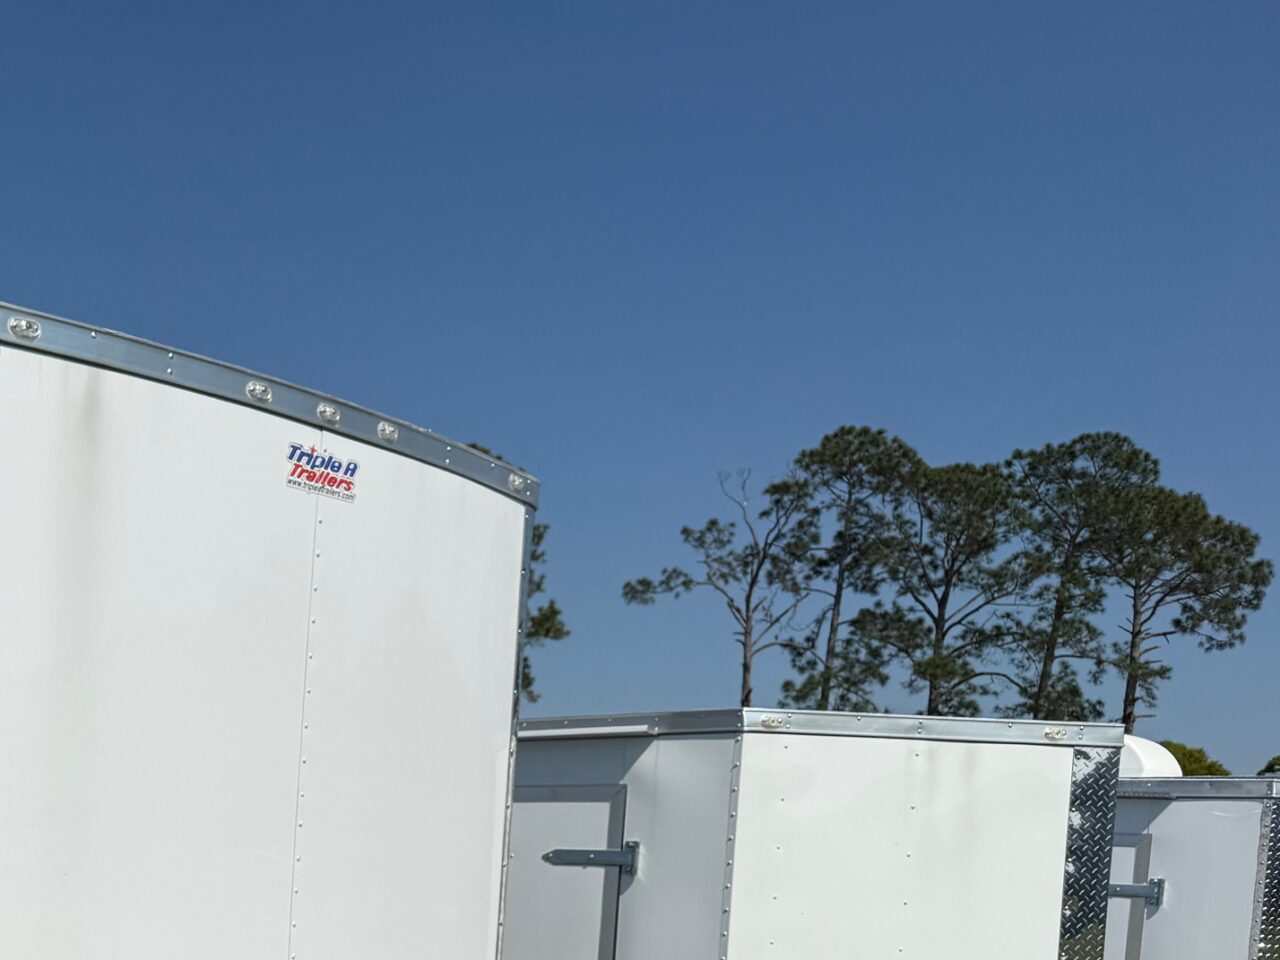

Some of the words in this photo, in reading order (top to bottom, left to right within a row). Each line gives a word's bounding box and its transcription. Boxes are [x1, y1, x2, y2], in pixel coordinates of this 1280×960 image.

[288, 444, 342, 473] Triple
[343, 461, 358, 477] A
[290, 463, 354, 491] Trailers
